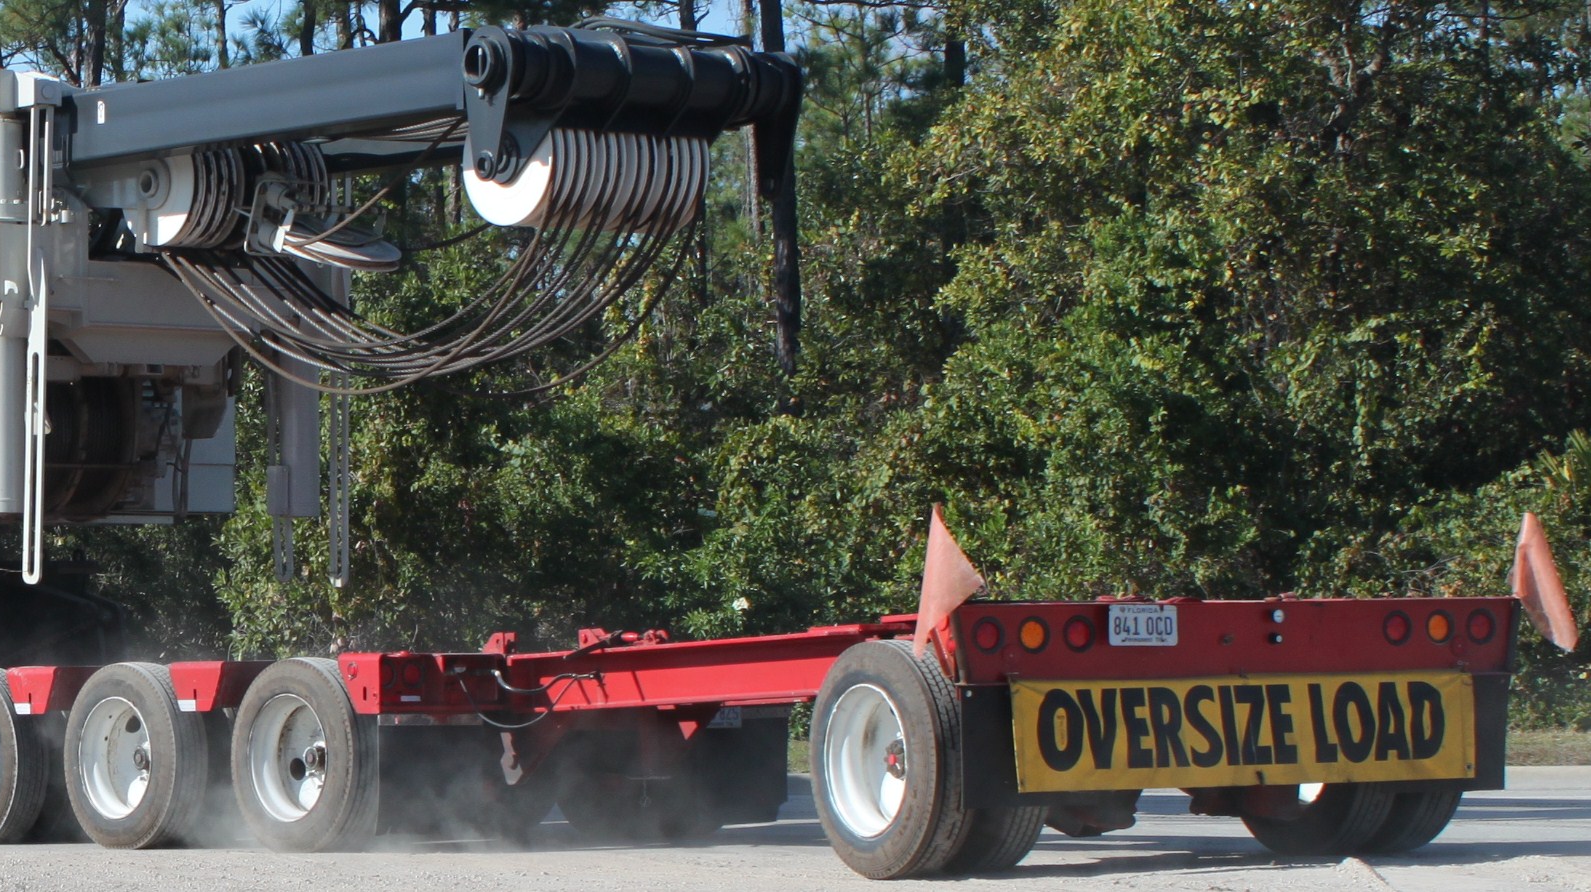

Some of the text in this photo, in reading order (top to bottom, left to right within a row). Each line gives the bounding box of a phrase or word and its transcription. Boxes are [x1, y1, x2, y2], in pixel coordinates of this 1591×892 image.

[1114, 616, 1140, 636] 841
[1037, 684, 1298, 772] OVERSIZE
[1308, 680, 1445, 764] LOAD
